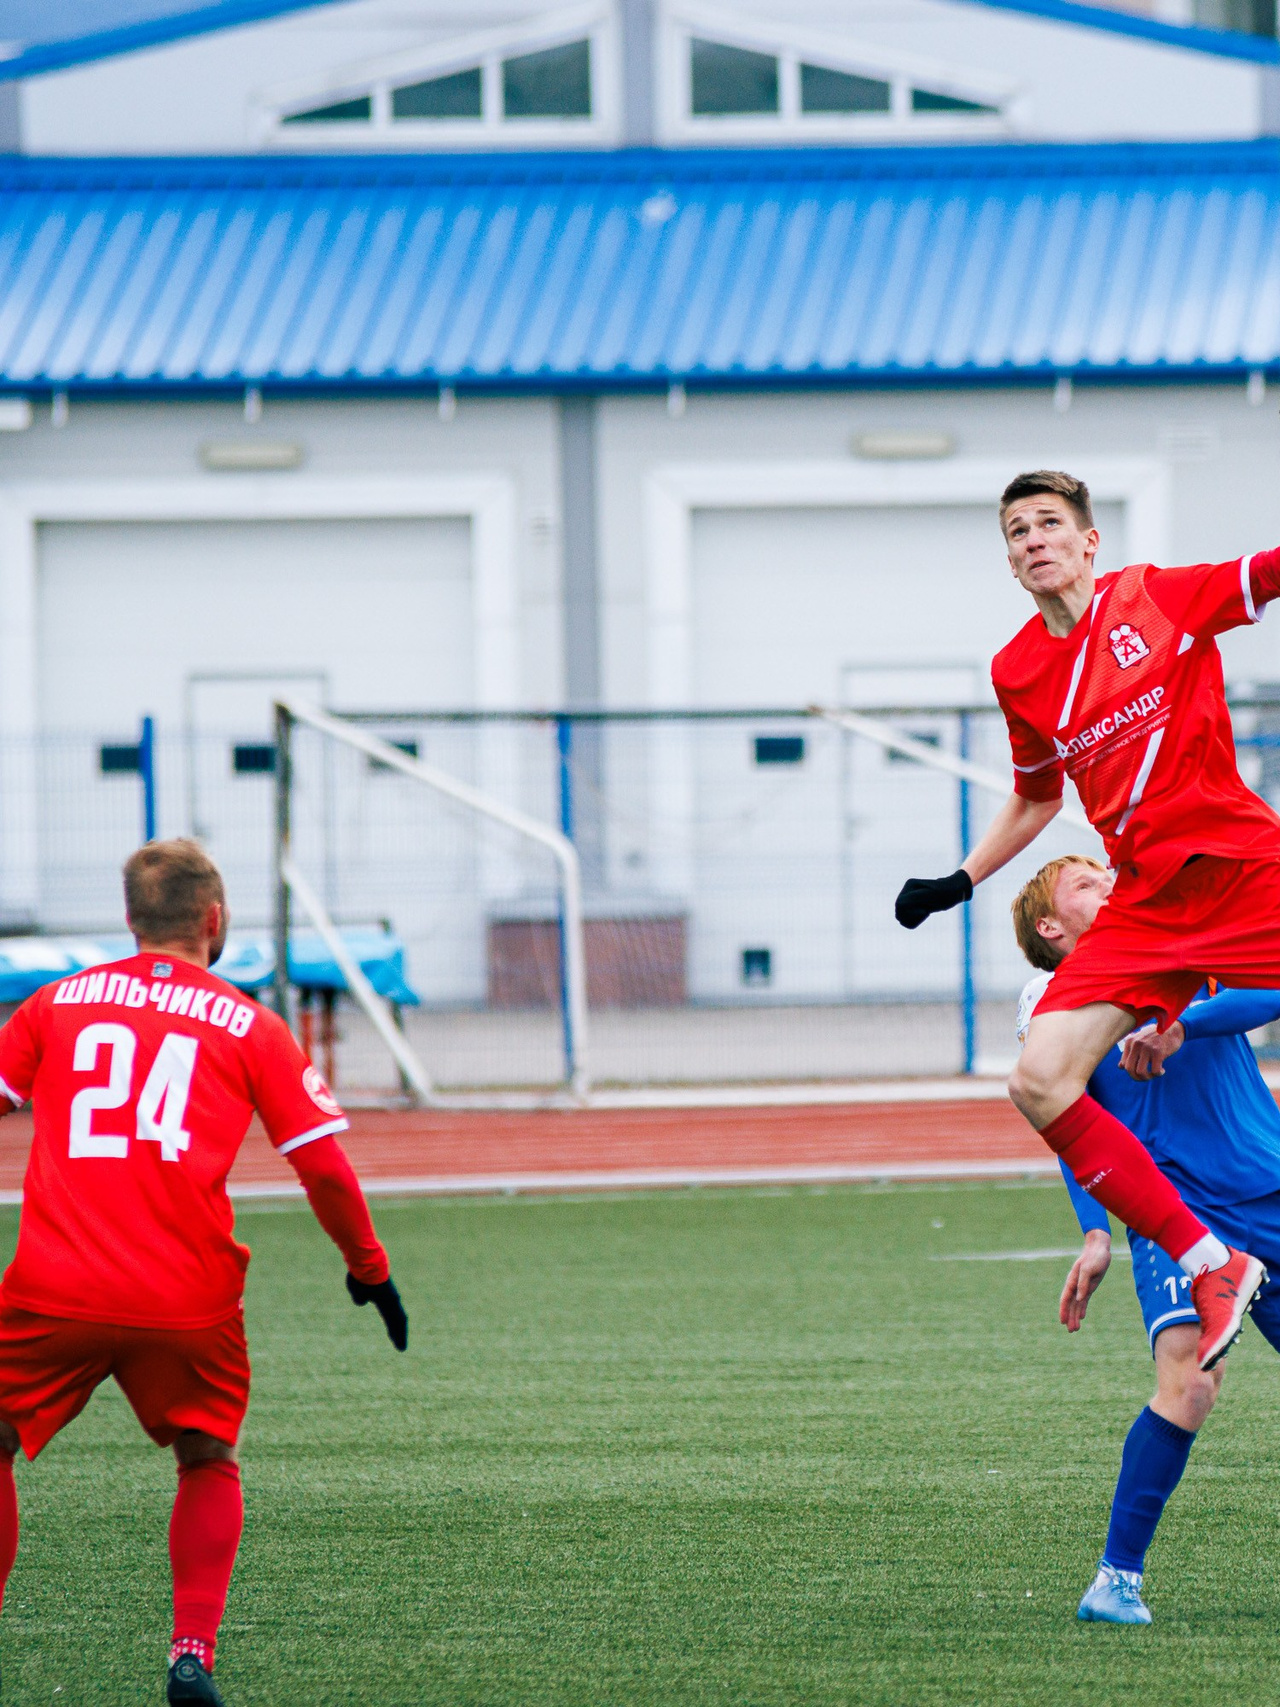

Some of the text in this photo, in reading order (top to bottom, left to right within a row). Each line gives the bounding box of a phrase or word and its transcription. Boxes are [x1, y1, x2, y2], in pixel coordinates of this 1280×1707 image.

[1053, 685, 1165, 760] АЛЕКСАНДР
[52, 971, 256, 1038] ШИЛЬЧИКОВ
[67, 1021, 200, 1163] 24
